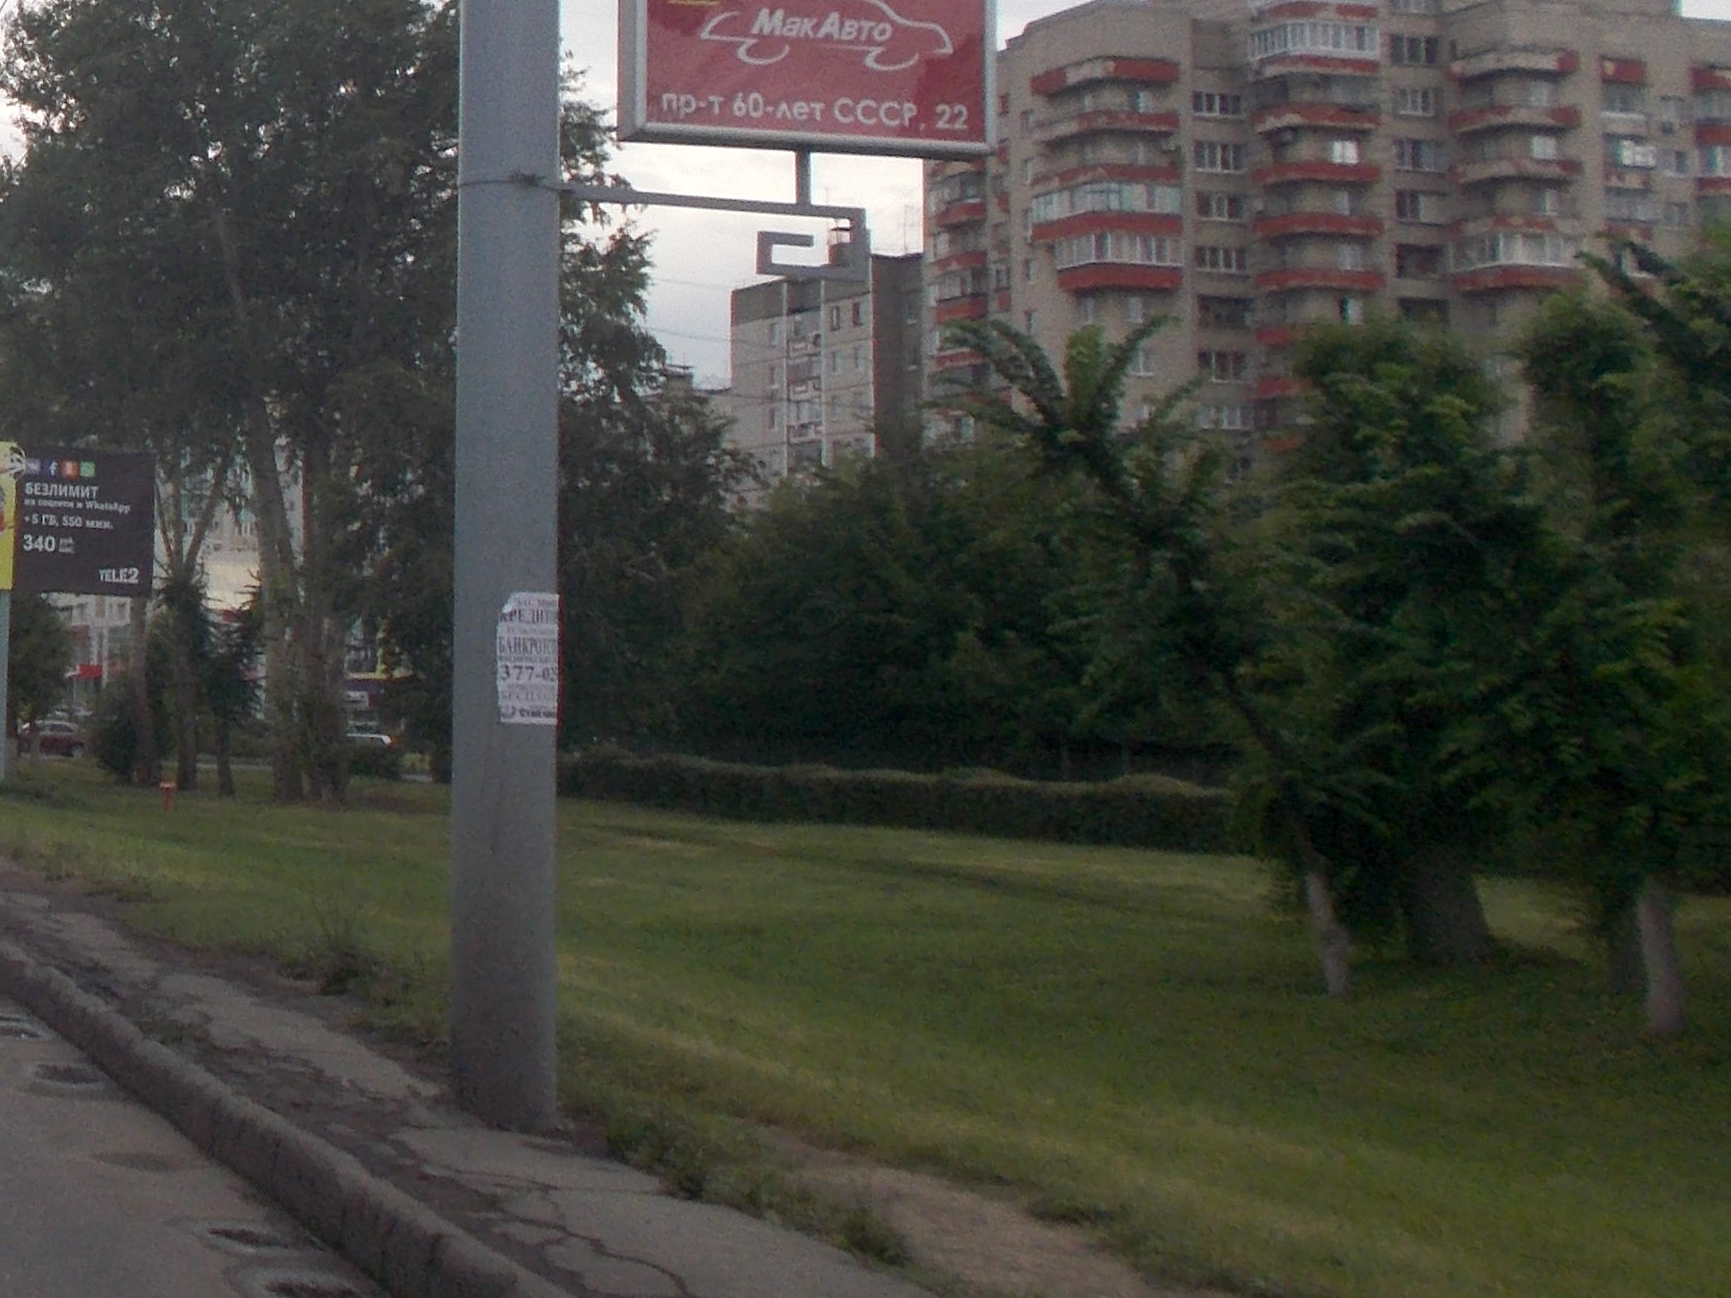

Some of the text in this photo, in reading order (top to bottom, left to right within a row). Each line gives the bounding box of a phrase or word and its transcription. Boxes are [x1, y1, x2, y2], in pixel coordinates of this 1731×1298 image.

[752, 8, 893, 42] МакАвто
[661, 91, 724, 119] пр-т
[732, 92, 825, 122] 60-лет
[935, 104, 969, 130] 22
[24, 482, 100, 499] БЕЗЛИМИТ
[23, 533, 56, 552] 340
[98, 567, 139, 584] TELE2
